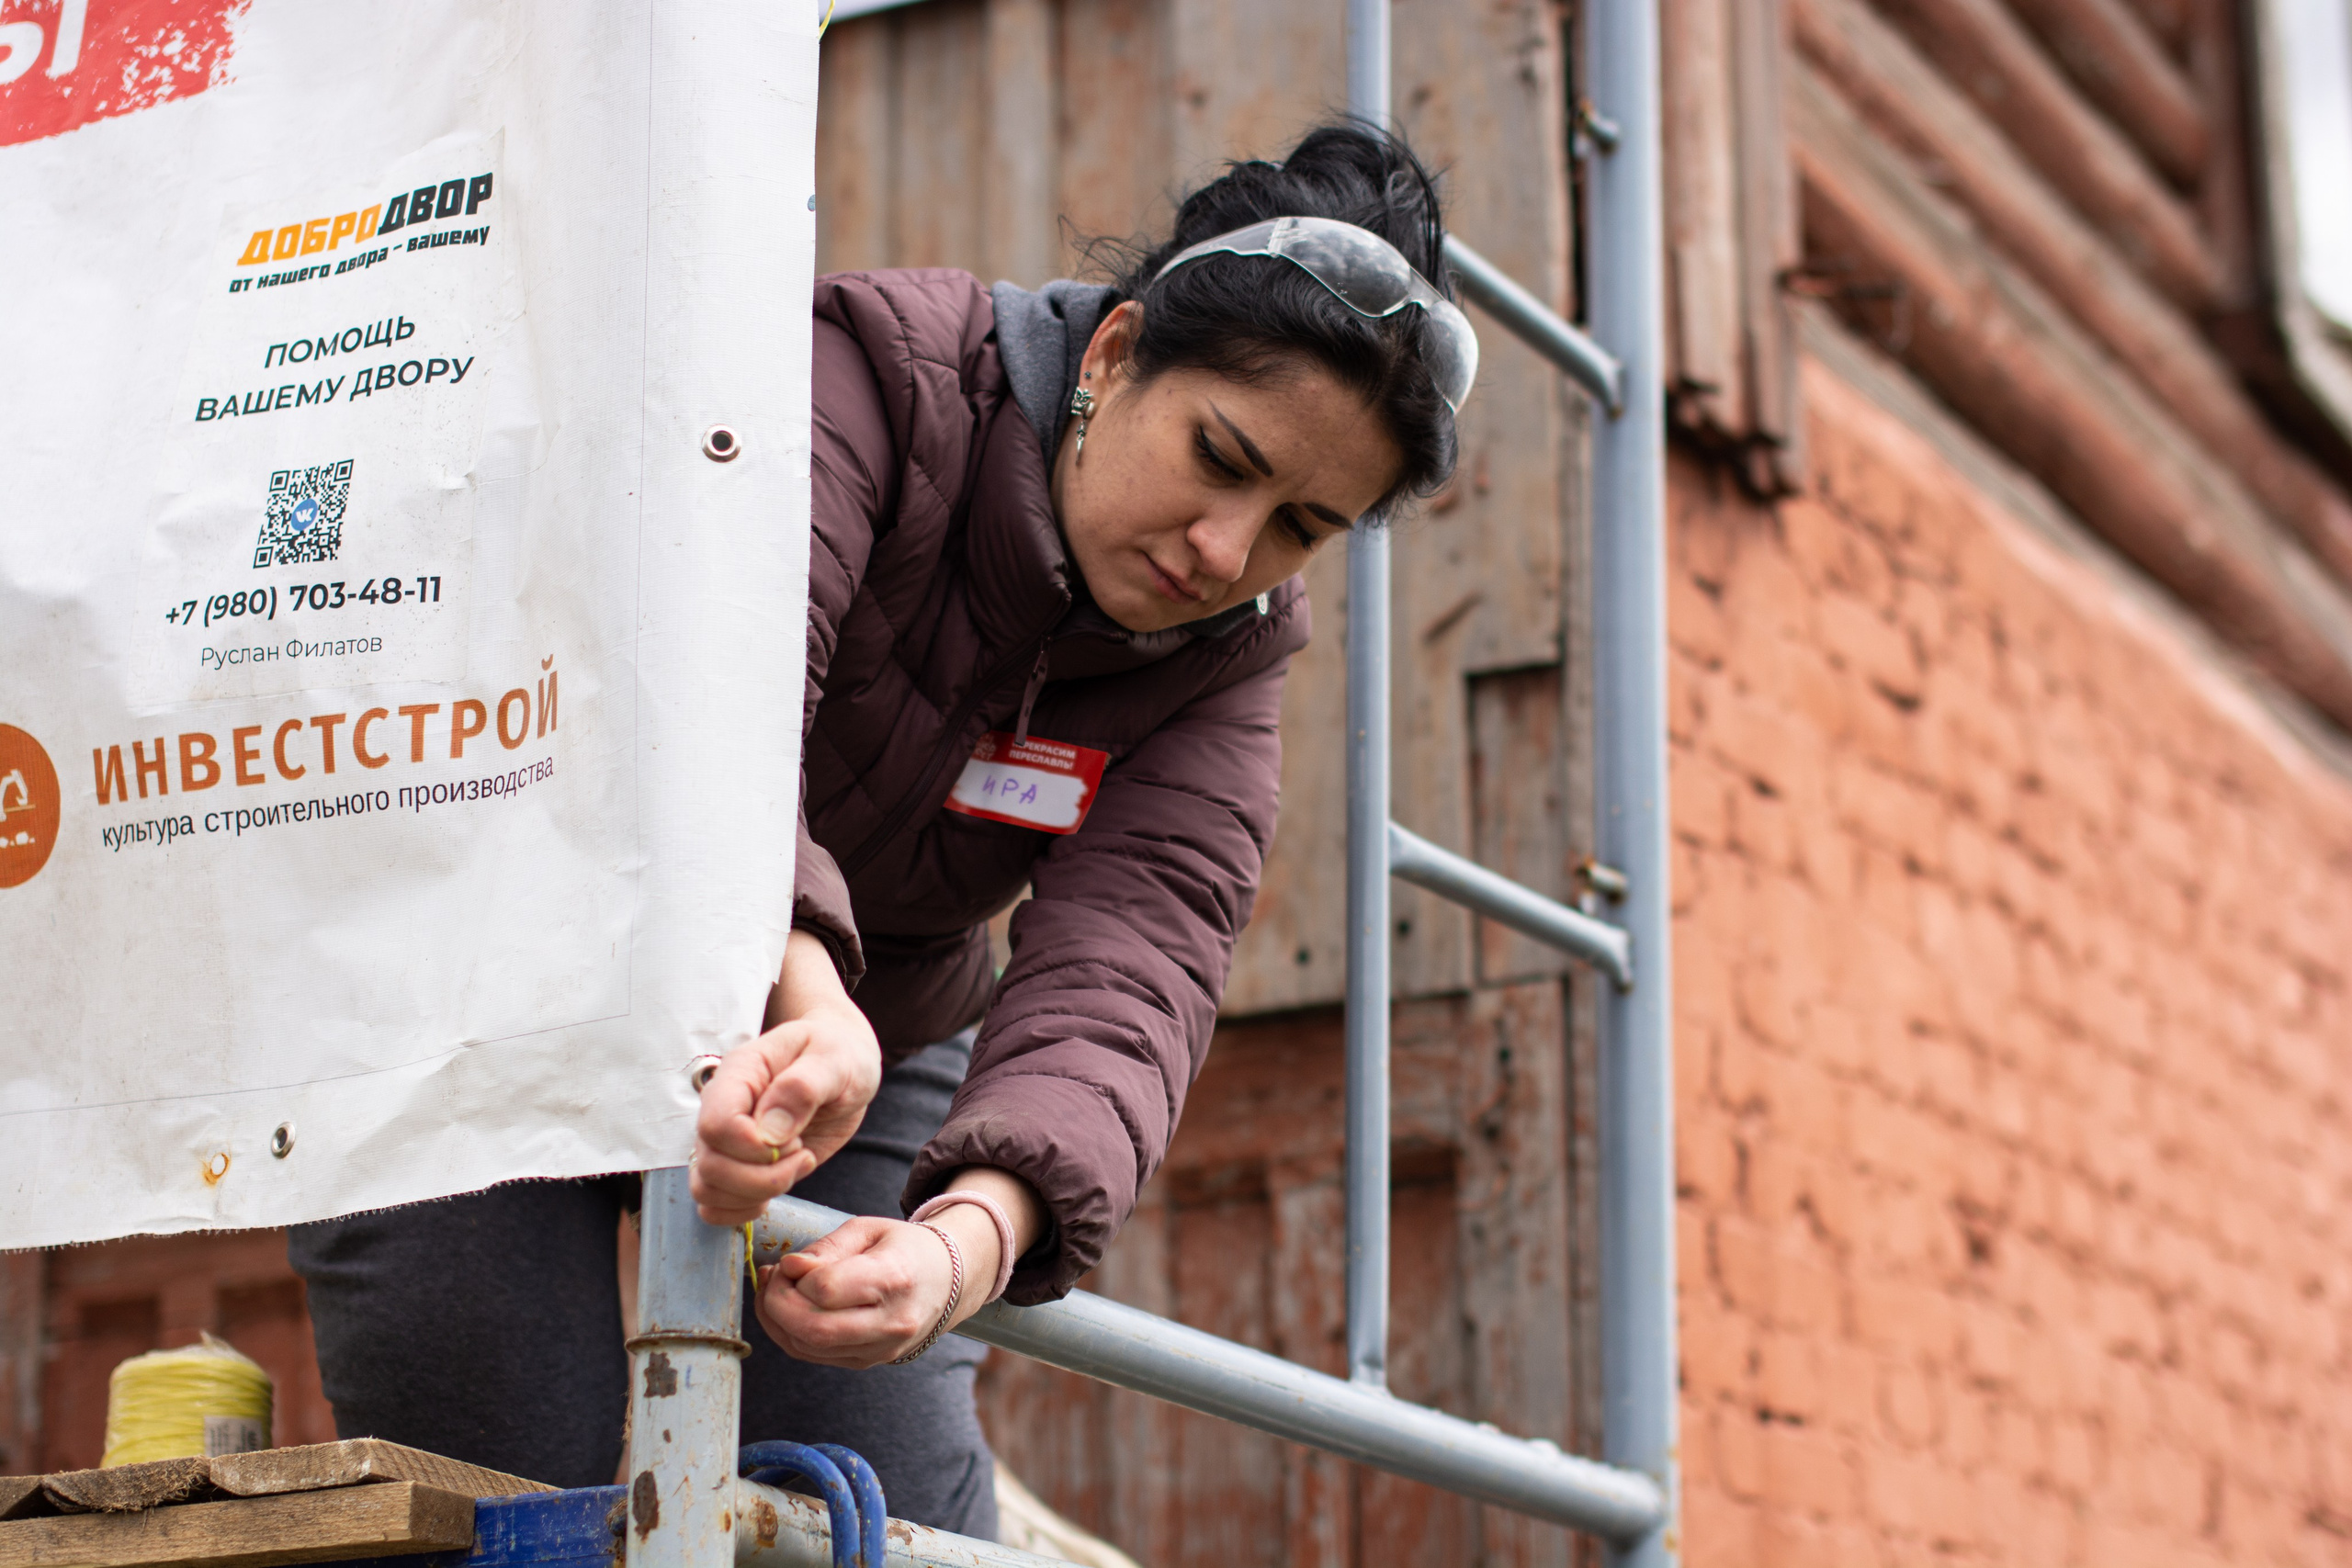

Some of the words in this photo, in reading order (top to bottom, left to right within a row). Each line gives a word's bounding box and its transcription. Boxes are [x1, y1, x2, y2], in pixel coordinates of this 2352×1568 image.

[236, 172, 494, 266] ДОБРОДВОР
[229, 277, 254, 293] от
[256, 263, 331, 290] нашего
[334, 246, 389, 276] двора
[406, 225, 491, 253] вашему
[263, 315, 416, 369] ПОМОЩЬ
[194, 375, 346, 423] ВАШЕМУ
[349, 355, 476, 402] ДВОРУ
[164, 600, 198, 626] +7
[203, 585, 277, 628] (980)
[289, 575, 442, 612] 703-48-11
[200, 645, 279, 671] Руслан
[286, 637, 383, 660] Филатов
[92, 653, 559, 807] ИНВЕСТСТРОЙ
[1012, 739, 1077, 760] РЕКРАСИМ
[102, 815, 196, 853] культура
[204, 790, 390, 838] строительного
[399, 756, 555, 814] производства
[981, 774, 1039, 805] ИРА
